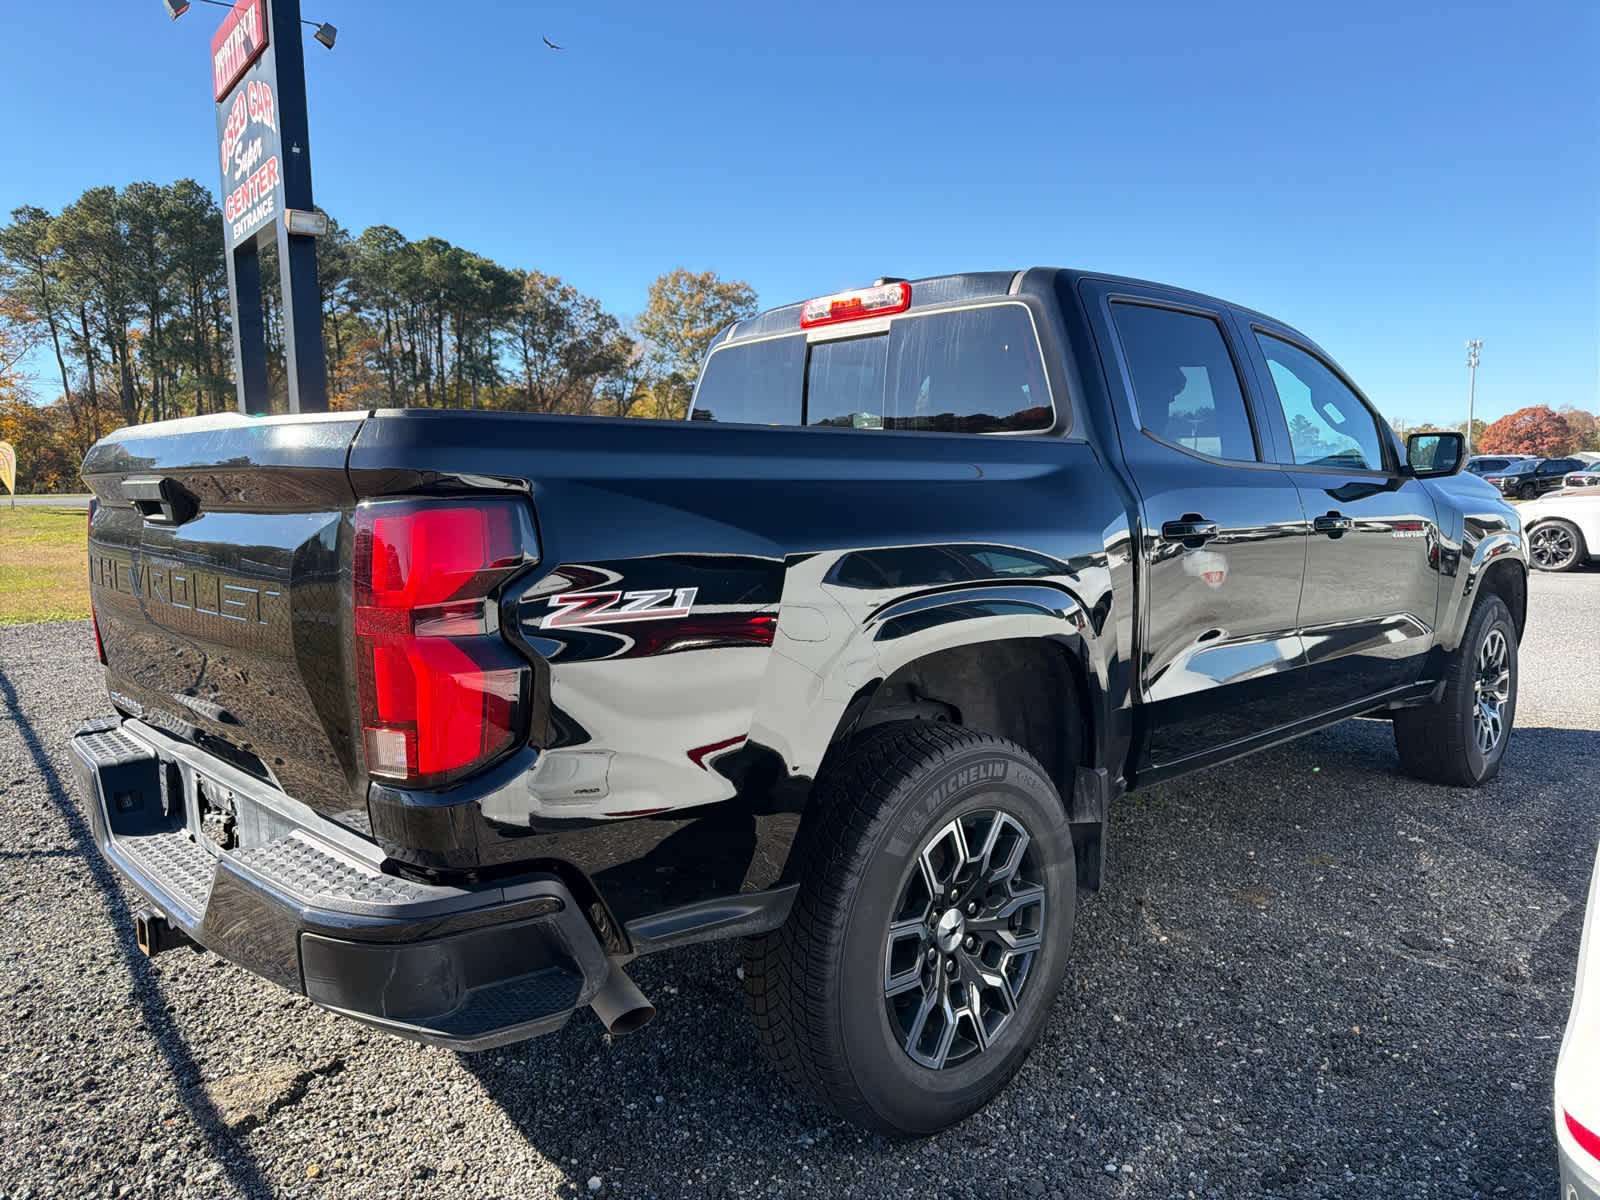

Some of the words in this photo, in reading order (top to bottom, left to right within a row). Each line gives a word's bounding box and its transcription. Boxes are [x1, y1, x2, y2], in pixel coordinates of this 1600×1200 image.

[221, 91, 246, 176] USED
[247, 80, 276, 132] CAR
[225, 156, 280, 223] CENTER
[233, 196, 275, 240] ENTRANCE
[90, 555, 281, 625] CHEVROLET
[540, 587, 699, 629] Z71
[927, 762, 1005, 812] MICHELIN
